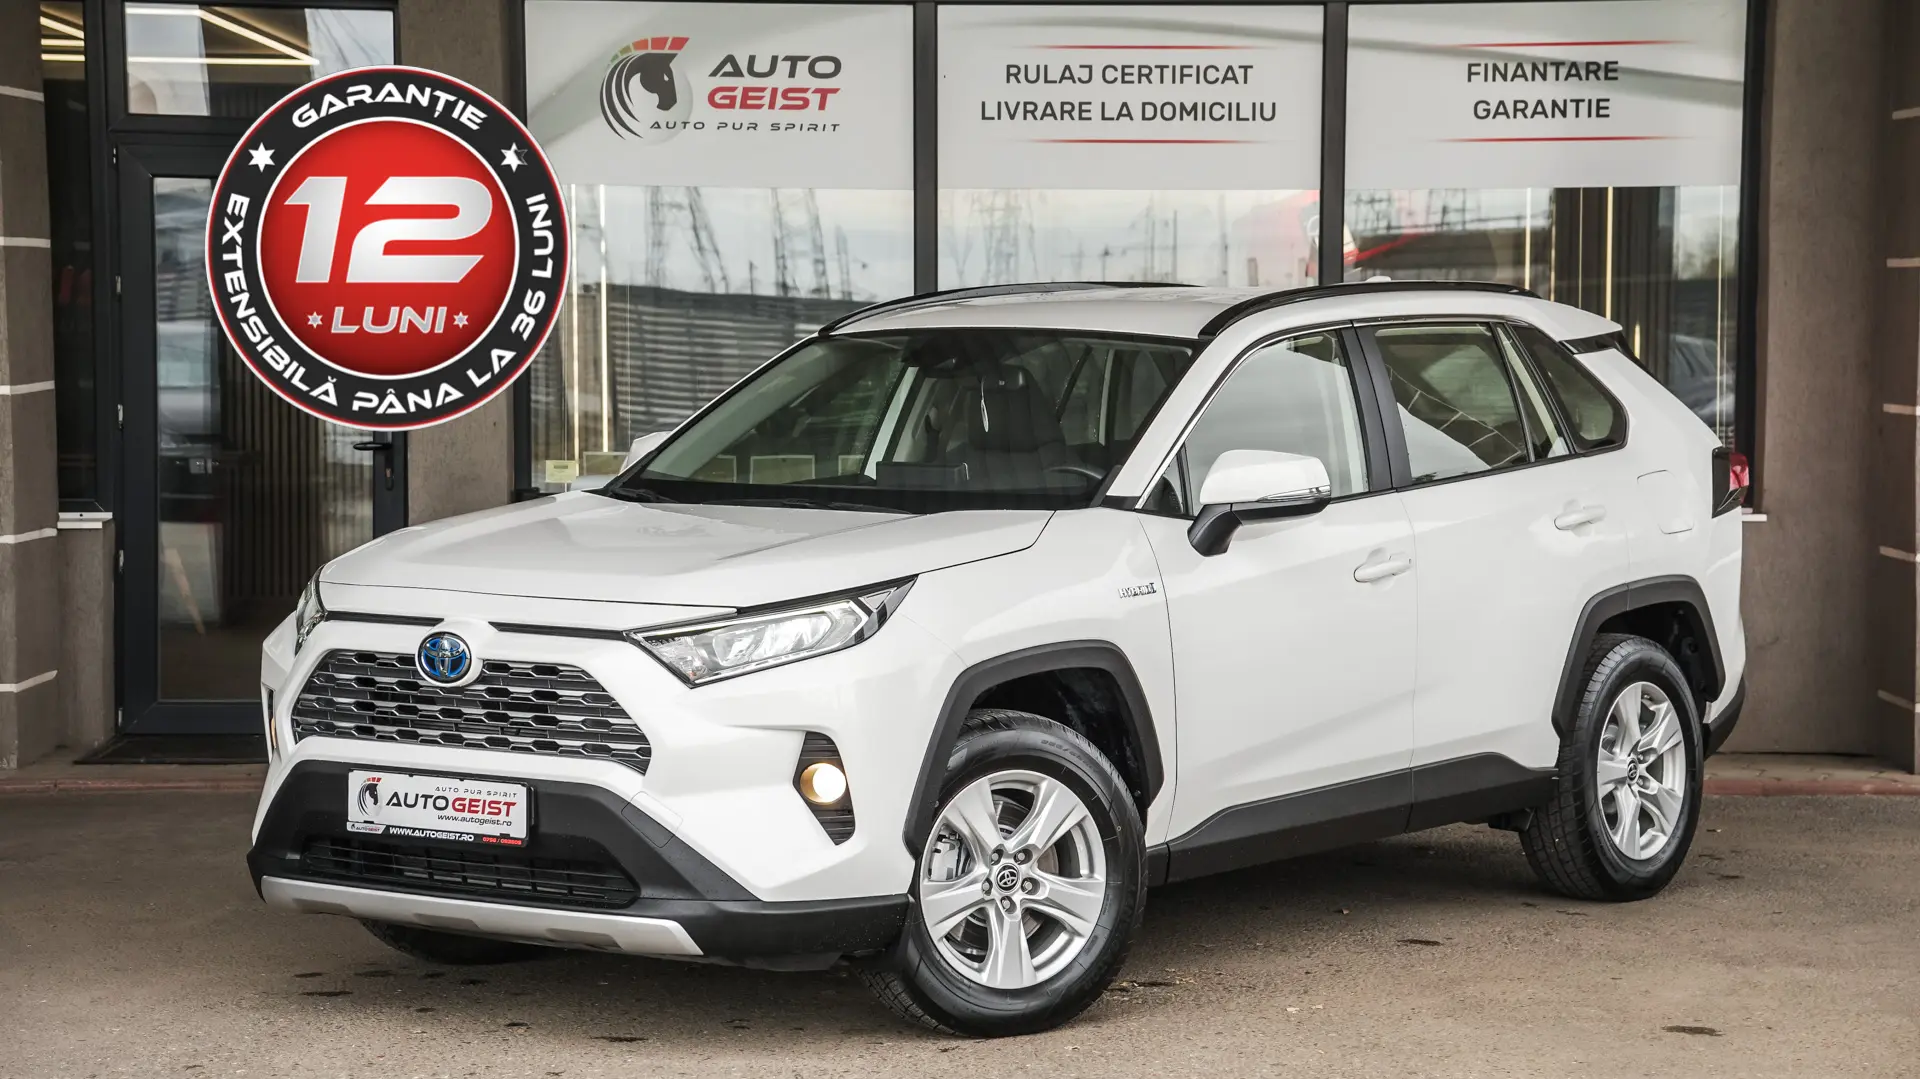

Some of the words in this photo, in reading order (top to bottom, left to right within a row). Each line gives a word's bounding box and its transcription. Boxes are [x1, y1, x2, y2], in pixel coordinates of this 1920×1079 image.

[708, 54, 842, 79] AUTO
[1006, 64, 1093, 84] RULAJ
[1101, 64, 1253, 85] CERTIFICAT
[1467, 60, 1619, 83] FINANTARE
[707, 86, 841, 111] GEIST
[1473, 98, 1610, 120] GARANTIE
[981, 101, 1092, 121] LIVRARE
[1100, 101, 1134, 121] LA
[1141, 101, 1277, 122] DOMICILIU
[650, 121, 705, 130] AUTO
[717, 122, 758, 131] PUR
[770, 122, 840, 132] SPIRIT
[386, 791, 517, 817] AUTOGEIST
[487, 790, 518, 798] SPIRIT
[437, 814, 512, 827] www.autogeist.ro
[389, 827, 475, 842] WWW.AUTOGEIST.RO
